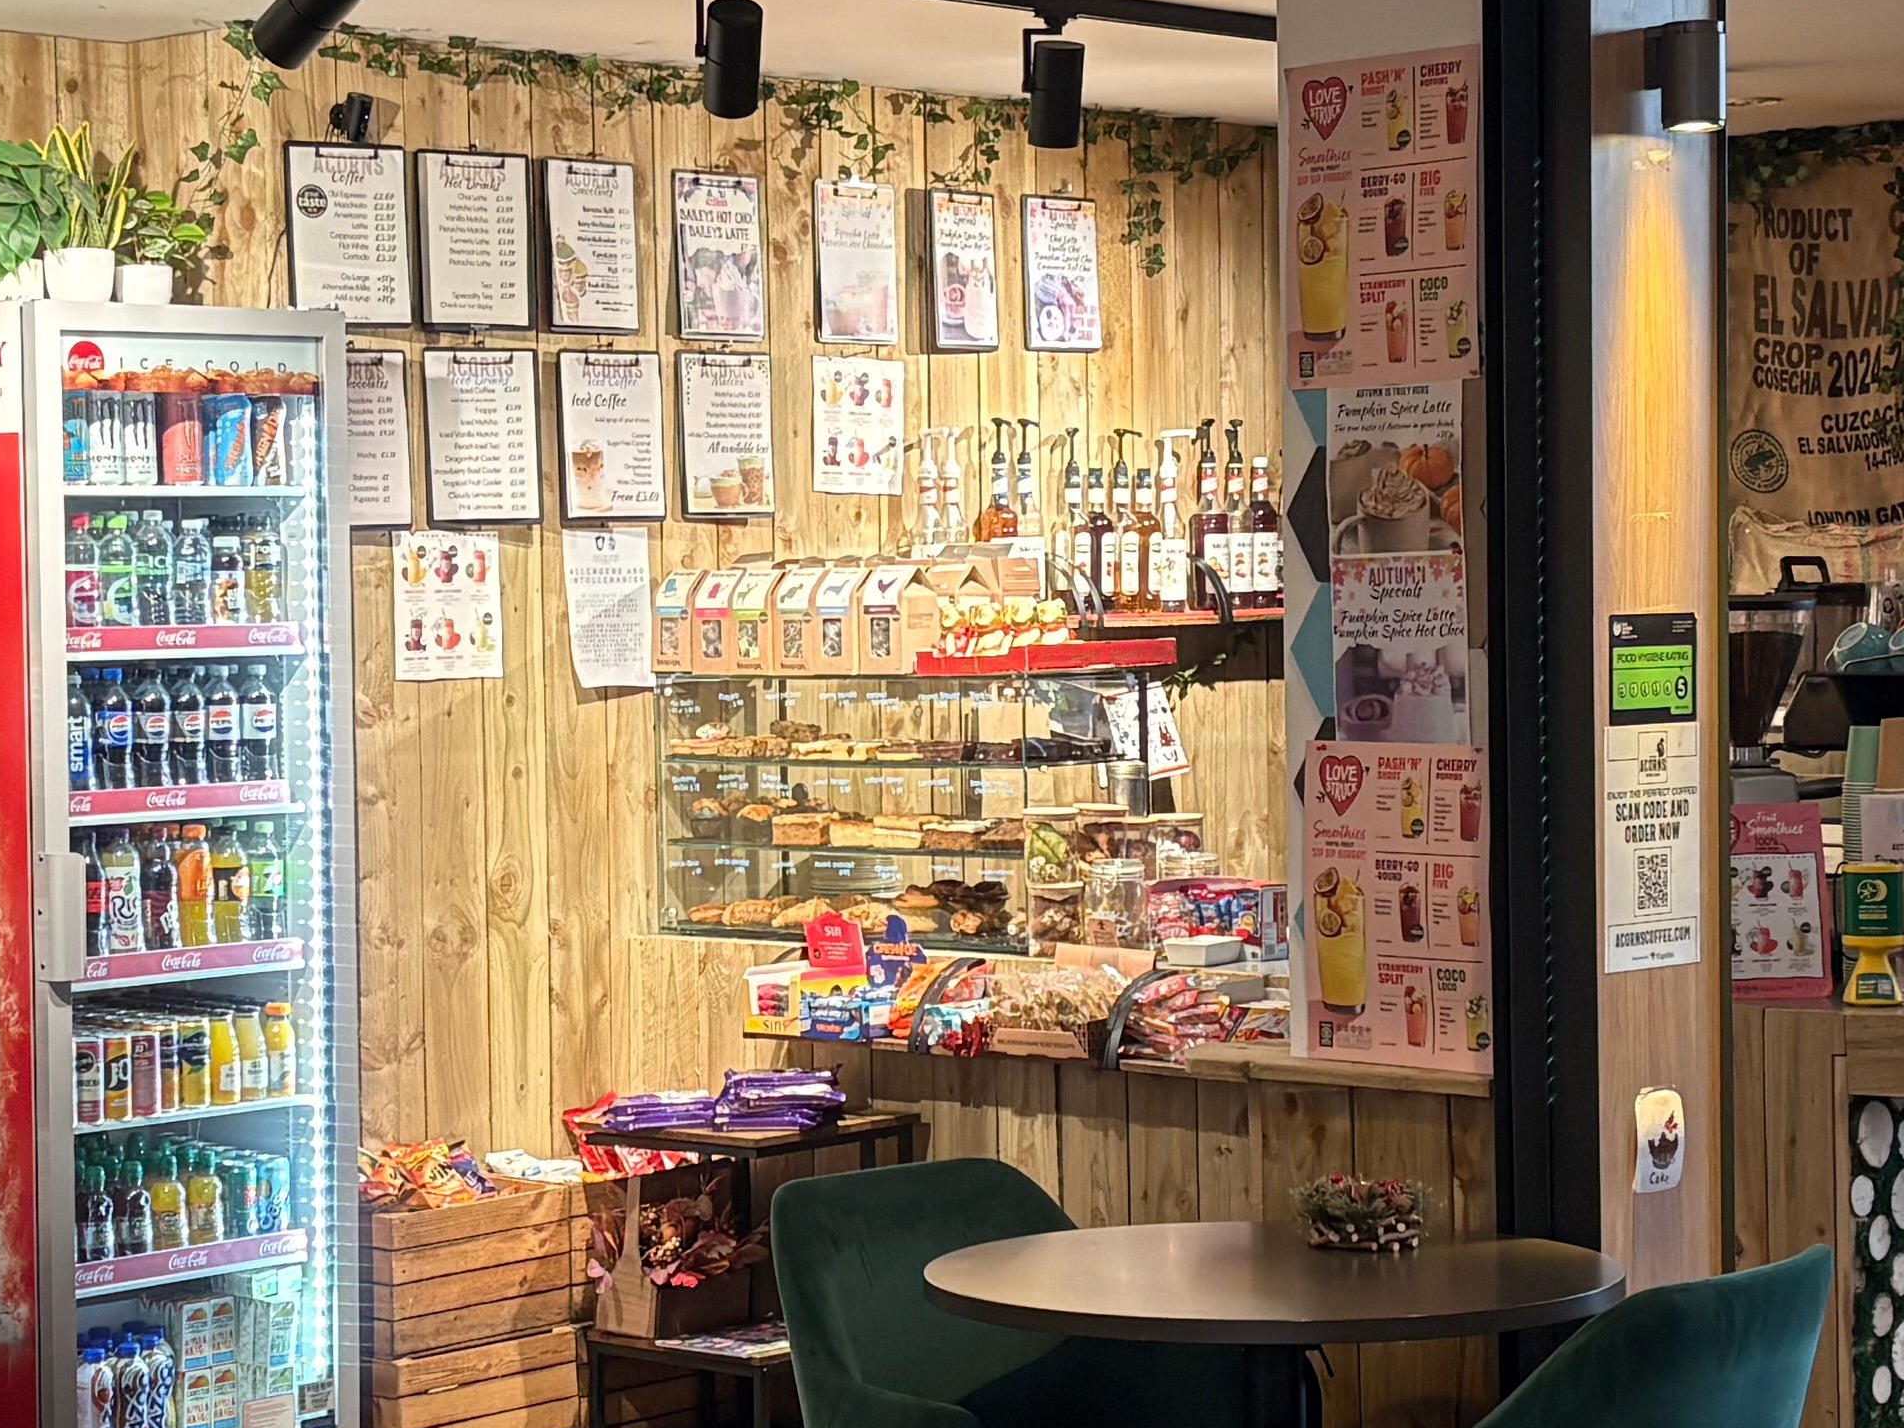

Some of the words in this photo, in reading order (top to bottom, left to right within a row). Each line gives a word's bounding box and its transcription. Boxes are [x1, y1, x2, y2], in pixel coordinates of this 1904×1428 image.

[1420, 60, 1462, 77] CHERRY
[1309, 87, 1342, 106] LOVE
[313, 153, 384, 175] ACORNS
[1299, 147, 1352, 167] Smoothies
[332, 172, 364, 185] Coffee
[444, 176, 463, 189] Hot
[1361, 173, 1406, 188] BERRY-GO
[1420, 170, 1441, 187] BIG
[725, 227, 749, 241] LATTE
[1789, 242, 1820, 276] OF
[1360, 279, 1406, 291] STRAWBERRY
[1420, 276, 1448, 291] COCO
[1360, 291, 1385, 304] SPLIT
[1420, 291, 1438, 302] LOCO
[1754, 274, 1784, 335] EL
[1754, 337, 1824, 369] CROP
[447, 357, 513, 377] ACORNS
[582, 358, 643, 379] ACORNS
[608, 376, 637, 389] Coffee
[1752, 365, 1823, 396] COSECHA
[572, 393, 591, 407] Iced
[595, 393, 627, 410] Coffee
[1338, 402, 1387, 421] Pumpkin
[1390, 401, 1419, 418] Spice
[1423, 400, 1452, 412] Latte
[1797, 436, 1814, 454] EL
[1369, 566, 1425, 586] AUTUMN
[1370, 582, 1422, 604] Specials
[1341, 608, 1389, 625] Pumpkin
[1392, 609, 1422, 628] Spice
[1426, 608, 1455, 622] Latte
[1334, 623, 1378, 644] Pumpkin
[1382, 624, 1411, 642] Spice
[1415, 623, 1436, 637] Hot
[1677, 678, 1685, 697] 5
[69, 716, 83, 773] smart
[1325, 764, 1358, 781] LOVE
[1378, 757, 1422, 771] PASH'N'
[1436, 758, 1477, 772] CHERRY
[1640, 759, 1667, 772] ACORNS
[1325, 782, 1358, 802] STRUCK
[1616, 802, 1640, 822] SCAN
[1643, 801, 1667, 819] CODE
[1670, 799, 1689, 817] AND
[1313, 820, 1366, 840] Smoothies
[1625, 824, 1656, 843] ORDER
[1659, 822, 1680, 841] NOW
[1746, 818, 1804, 837] Smoothies
[1754, 834, 1778, 845] 100%
[1375, 859, 1419, 872] BERRY-GO
[1433, 863, 1454, 879] BIG
[1615, 926, 1691, 949] ACORNSCOFFEE.COM
[1378, 973, 1404, 985] SPLIT
[1437, 968, 1466, 983] COCO
